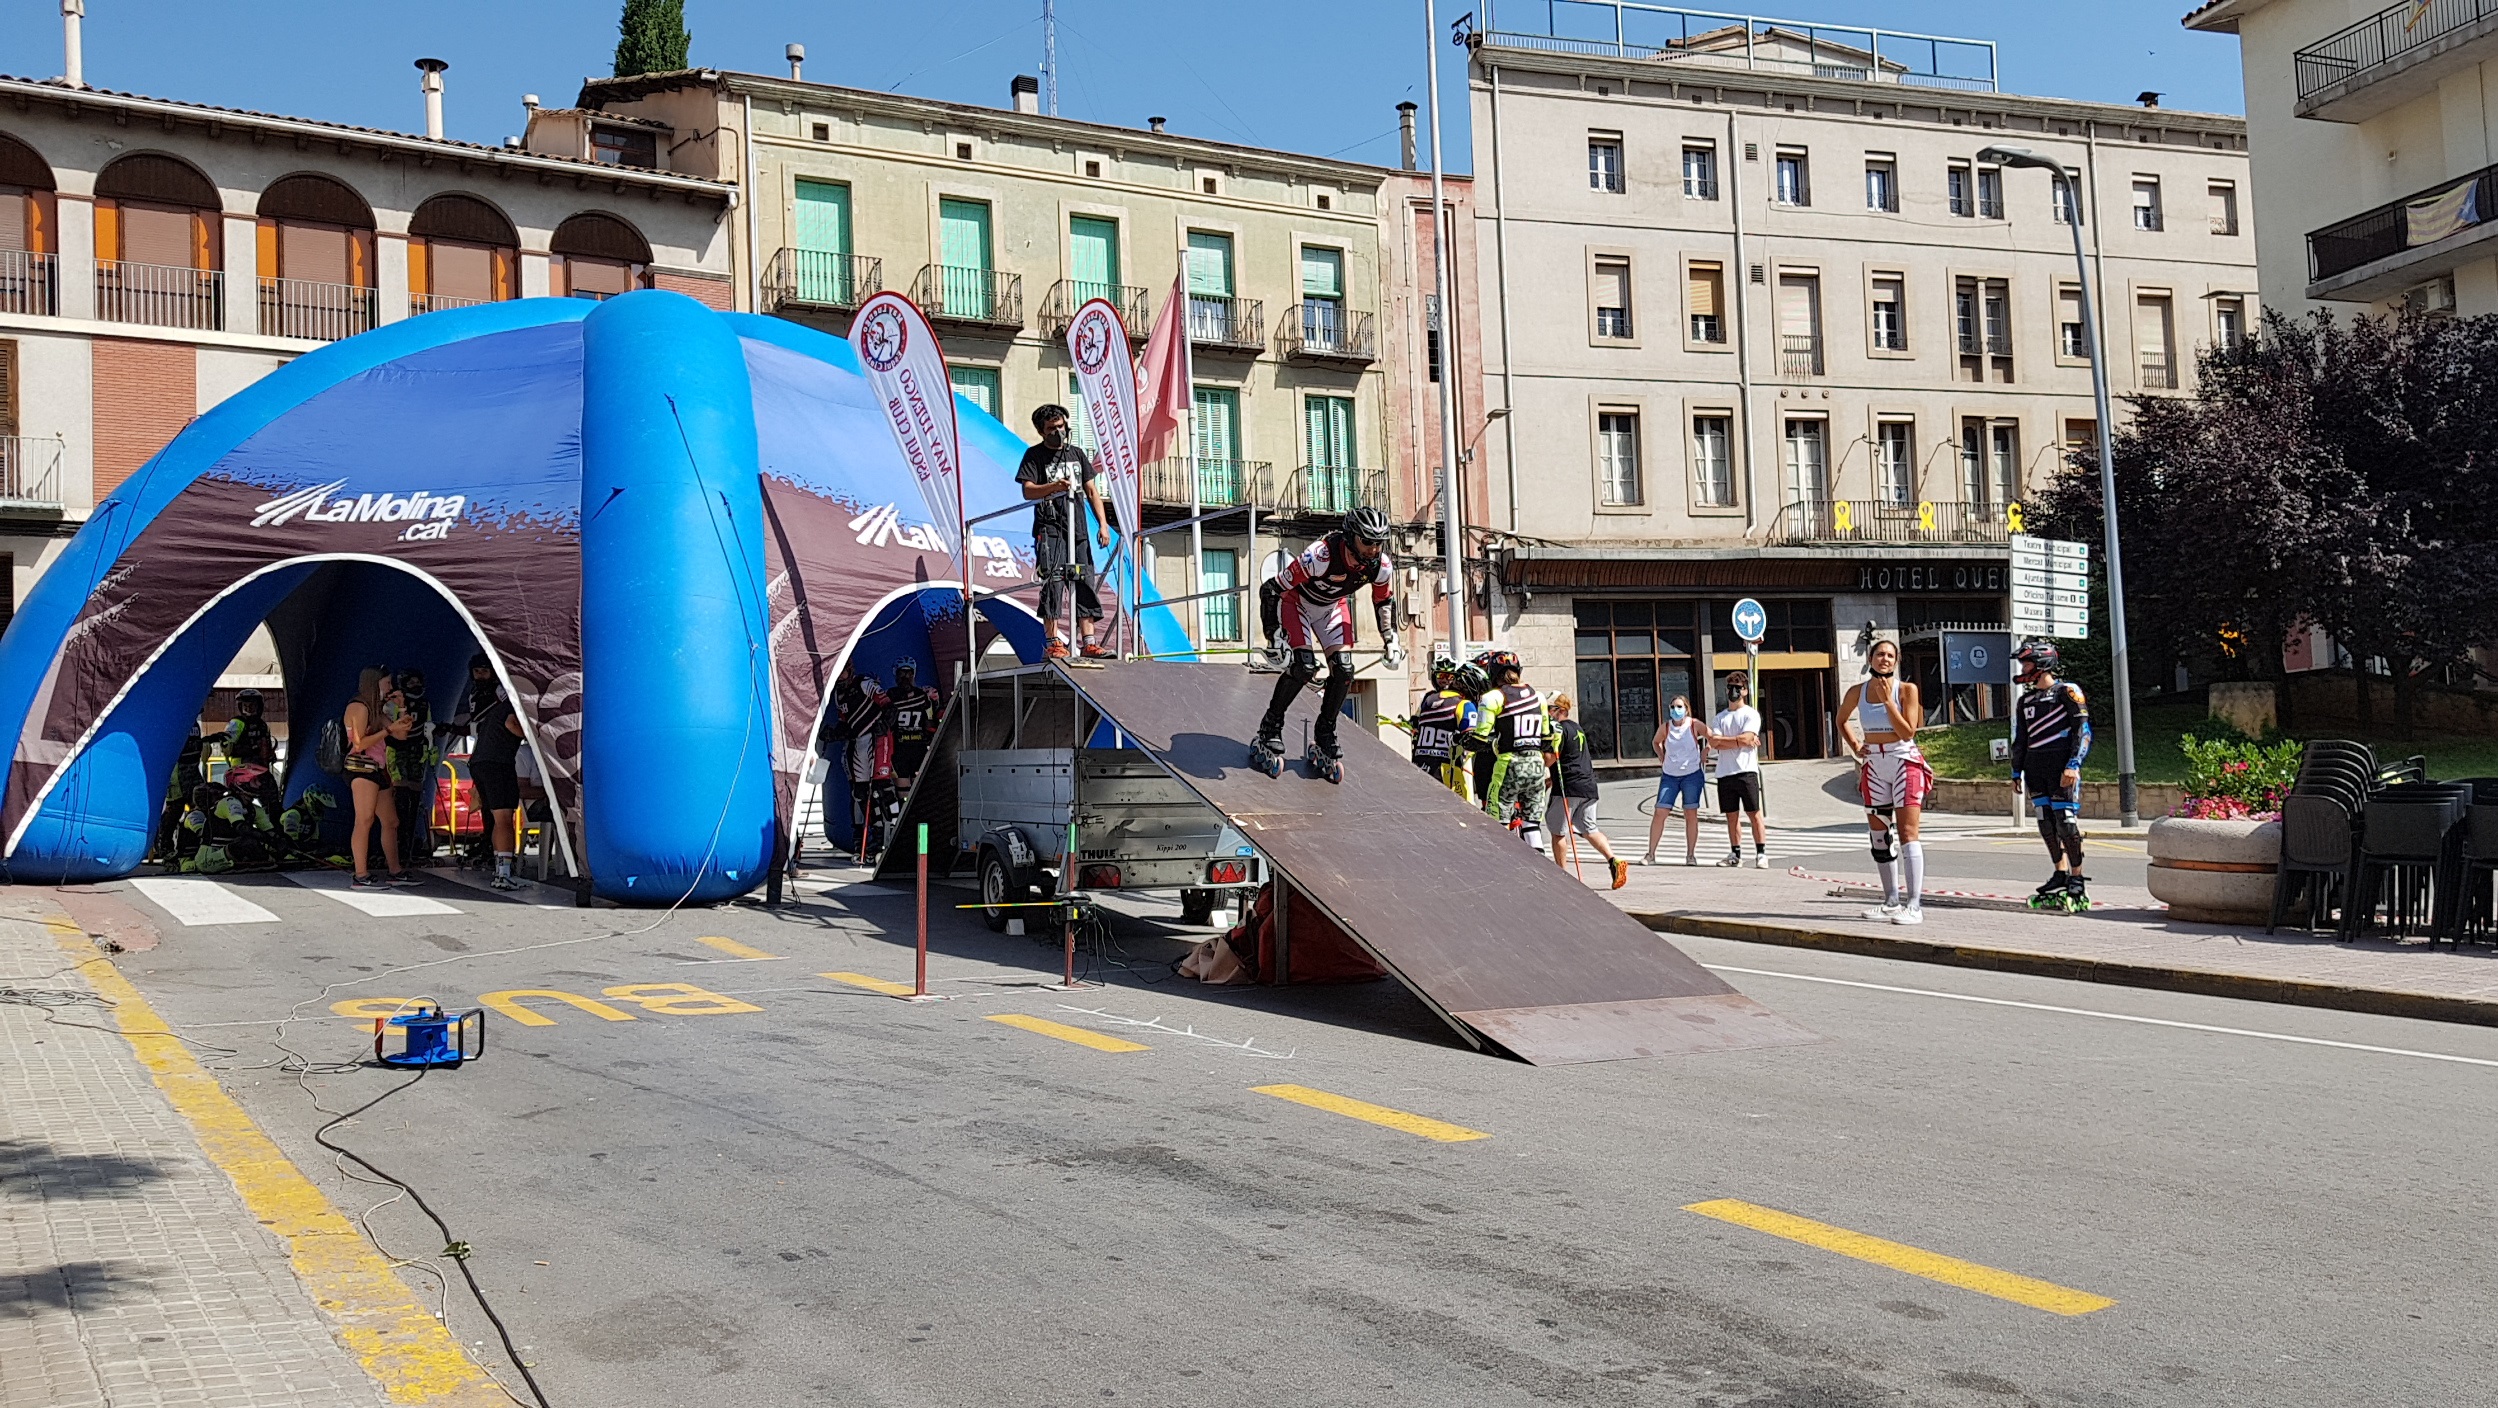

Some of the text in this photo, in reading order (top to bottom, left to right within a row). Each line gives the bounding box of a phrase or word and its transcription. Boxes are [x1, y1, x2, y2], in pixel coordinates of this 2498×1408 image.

[304, 492, 466, 522] LaMolina
[398, 517, 454, 541] .cat
[985, 559, 1022, 578] .cat
[1861, 567, 1939, 590] HOTEL
[898, 711, 922, 727] 97
[1513, 714, 1542, 738] 107
[1417, 726, 1451, 748] 109
[1081, 849, 1116, 860] THULE
[1156, 844, 1174, 852] Kippi
